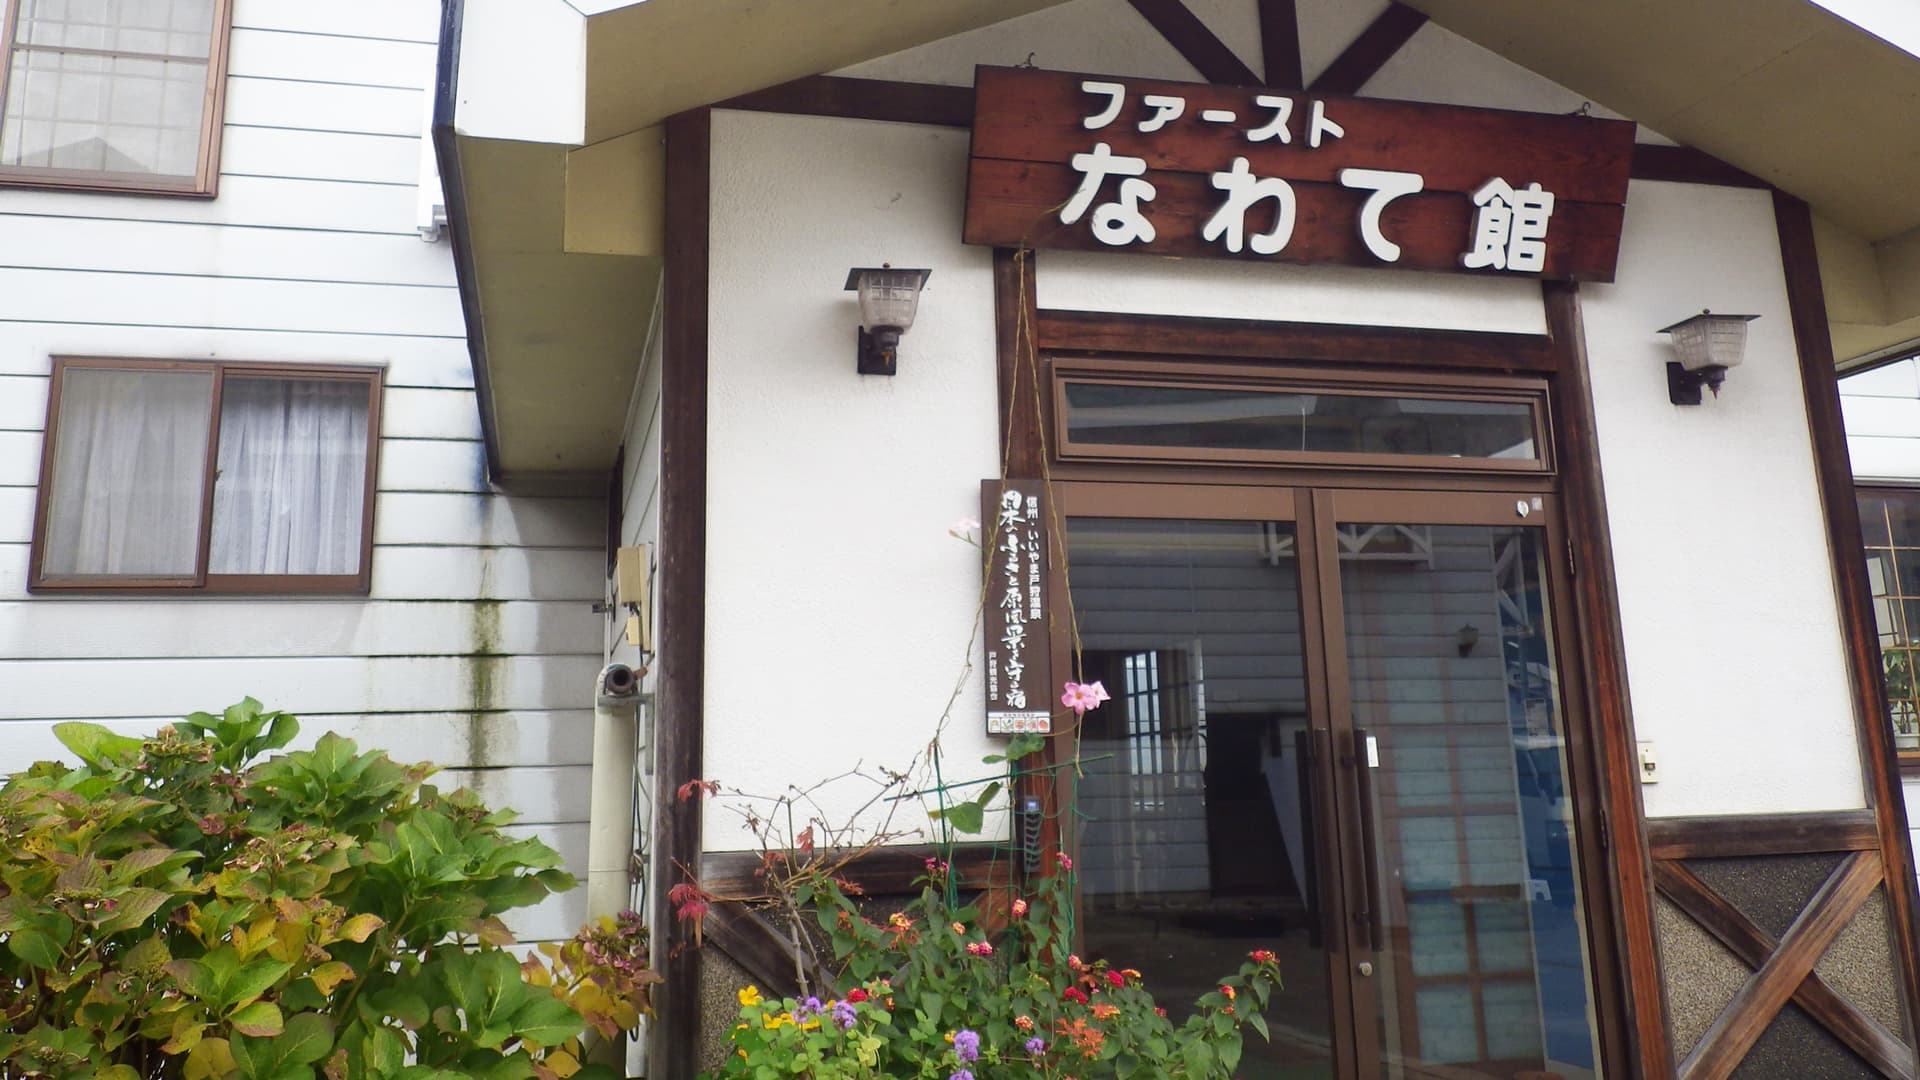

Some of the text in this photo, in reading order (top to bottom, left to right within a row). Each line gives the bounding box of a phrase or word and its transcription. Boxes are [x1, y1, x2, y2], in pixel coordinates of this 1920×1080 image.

[1079, 80, 1345, 149] ファースト
[1059, 142, 1555, 273] なわて館
